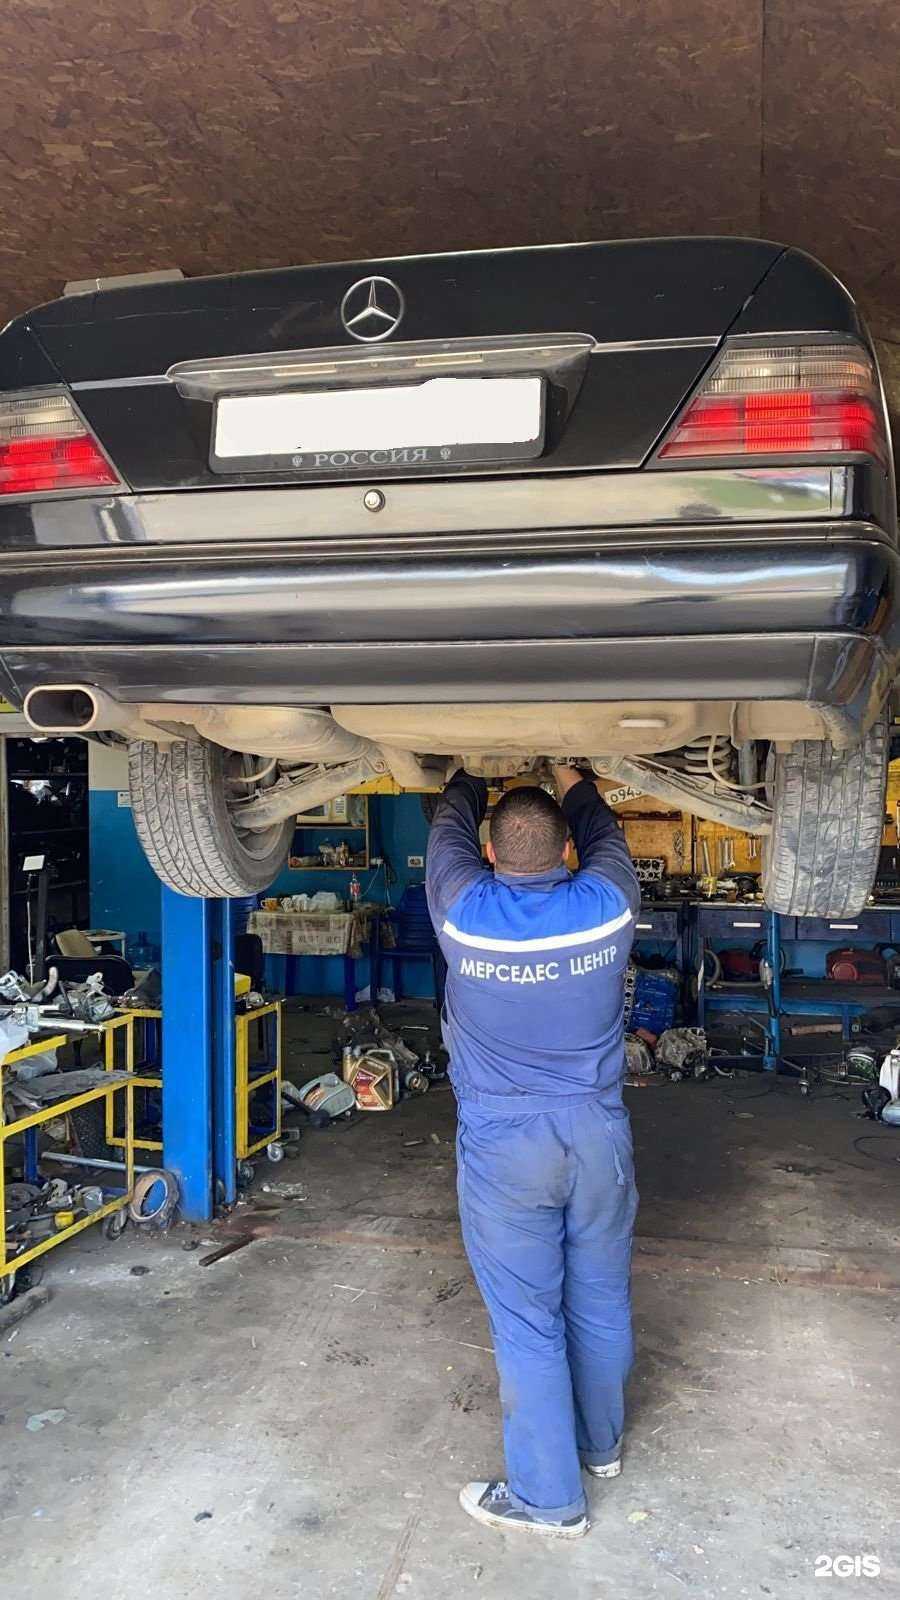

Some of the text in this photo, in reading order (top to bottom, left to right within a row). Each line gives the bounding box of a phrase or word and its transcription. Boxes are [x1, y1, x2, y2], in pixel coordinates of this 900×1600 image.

[314, 449, 427, 466] РОССИЯ
[460, 945, 617, 984] МЕРСЕДЕС ЦЕНТР
